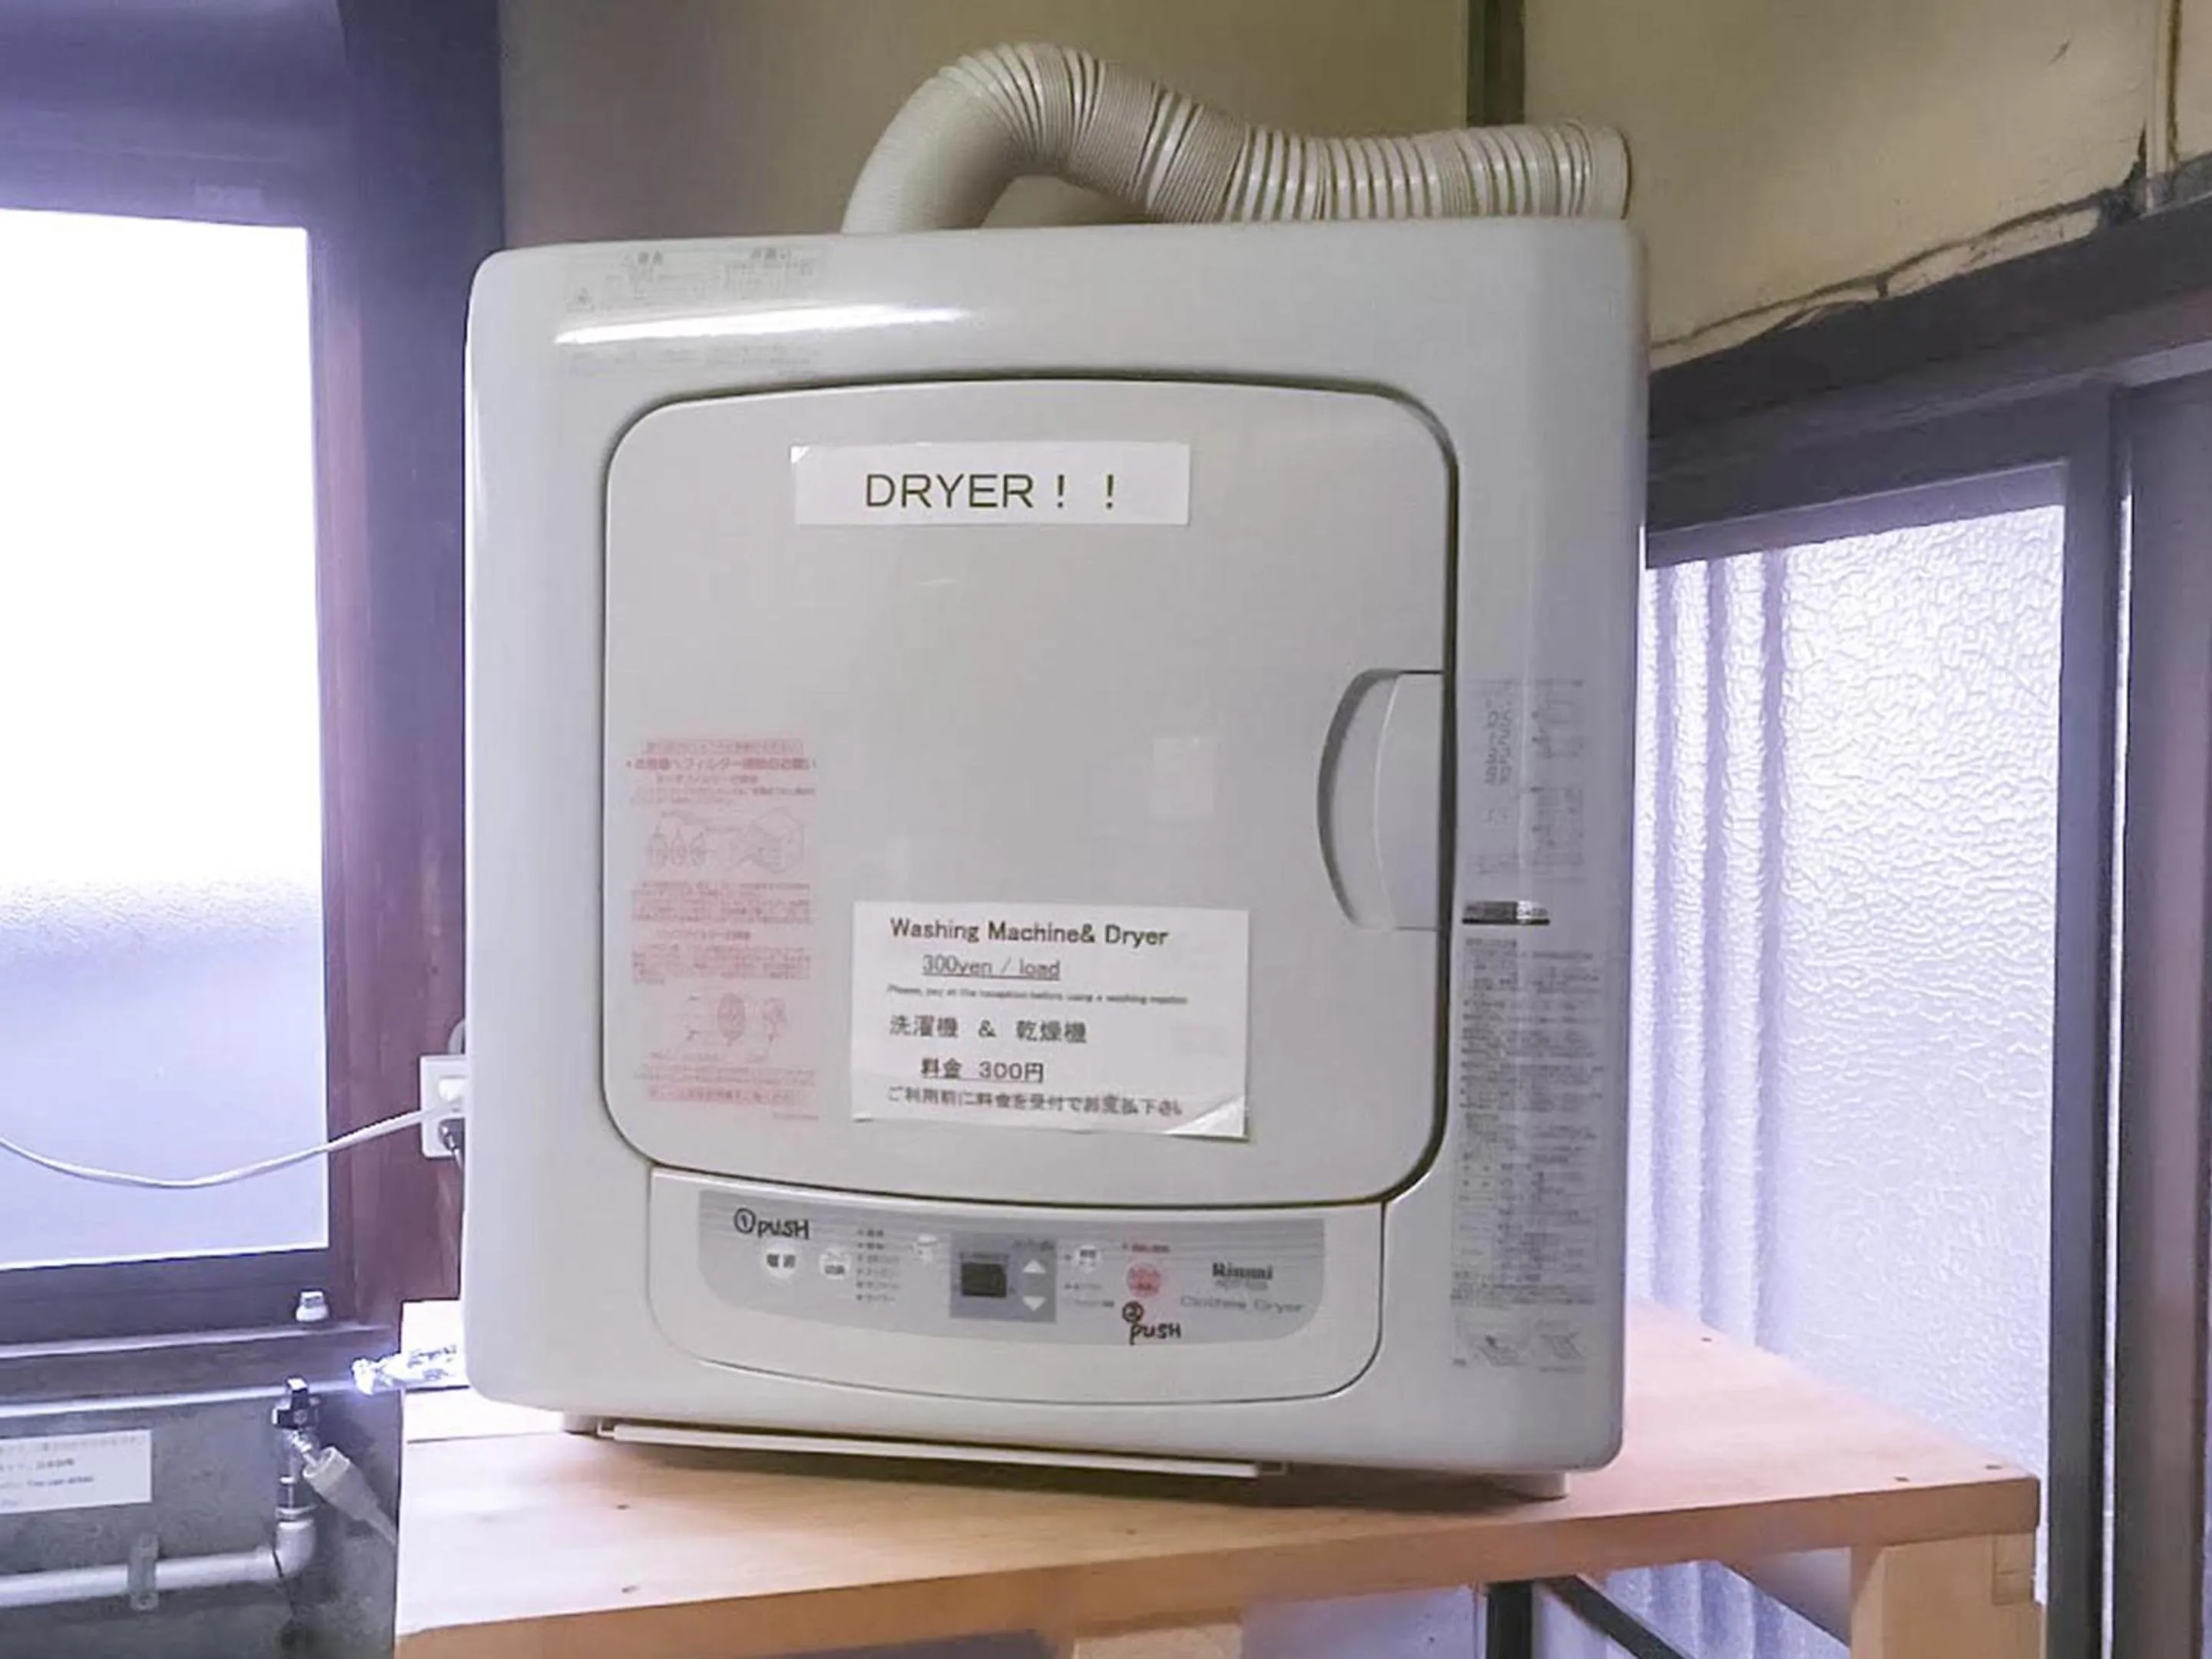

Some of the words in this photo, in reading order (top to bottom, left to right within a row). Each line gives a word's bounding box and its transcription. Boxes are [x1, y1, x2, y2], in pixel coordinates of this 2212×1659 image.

[865, 474, 1035, 508] DRYER
[890, 918, 979, 943] Washing
[1104, 924, 1169, 949] Dryer
[1018, 959, 1061, 977] load
[889, 1014, 959, 1038] 洗濯機
[977, 1019, 997, 1038] &
[1015, 1020, 1088, 1044] 乾燥機
[920, 1057, 963, 1079] 料金
[979, 1060, 1045, 1084] 300円
